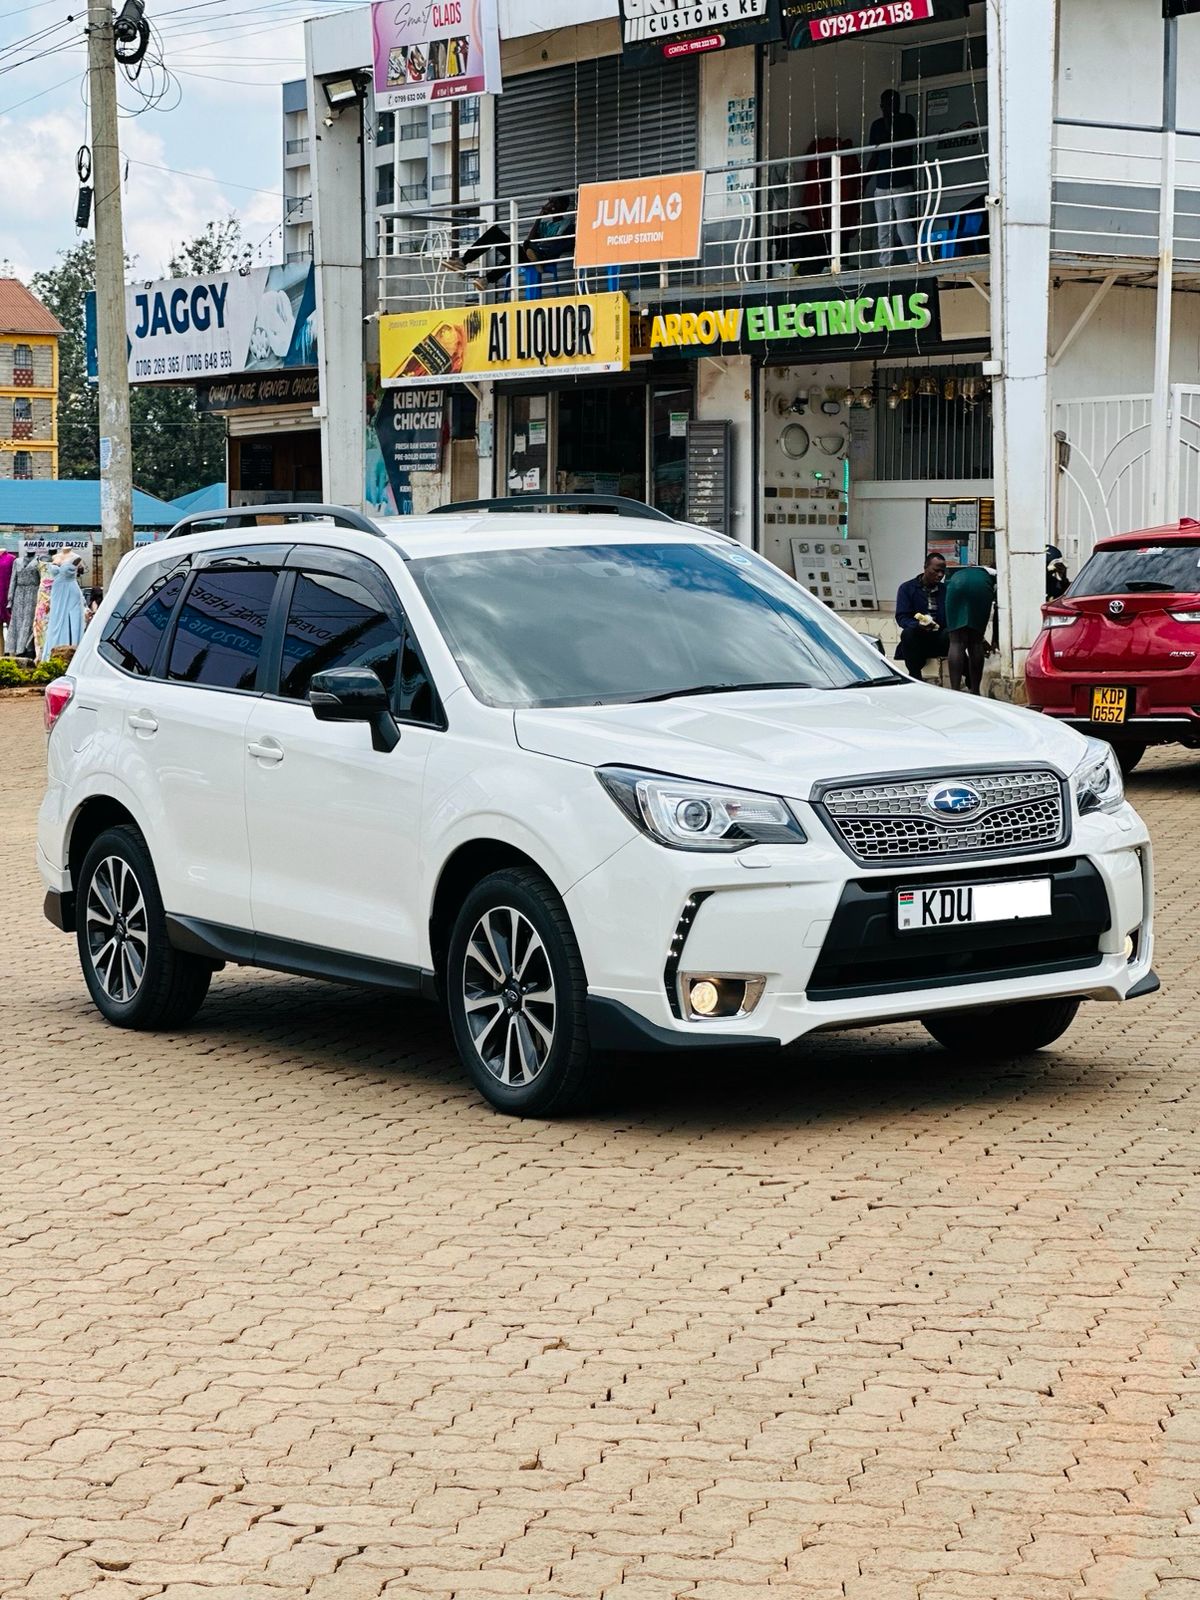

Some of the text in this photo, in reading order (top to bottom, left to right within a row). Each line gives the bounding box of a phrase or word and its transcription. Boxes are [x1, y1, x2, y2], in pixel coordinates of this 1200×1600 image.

[432, 1, 462, 28] CLADS
[649, 3, 729, 32] CUSTOMS
[739, 0, 758, 14] KE
[819, 1, 914, 38] 0792 222 158
[607, 231, 664, 246] PICKUP STATION
[135, 282, 229, 339] JAGGY
[650, 307, 744, 349] ARROW
[746, 292, 932, 341] ELECTRICALS
[488, 311, 510, 362] A1
[516, 303, 595, 366] LIQUOR
[135, 359, 152, 376] 0706
[186, 354, 202, 372] 0706
[204, 352, 218, 370] 648
[393, 390, 444, 410] KIENYEJI
[393, 411, 443, 431] CHICKEN
[24, 541, 46, 549] AHADI
[65, 541, 89, 549] DAZZLE
[1101, 688, 1125, 705] KDP
[922, 887, 973, 926] KDU
